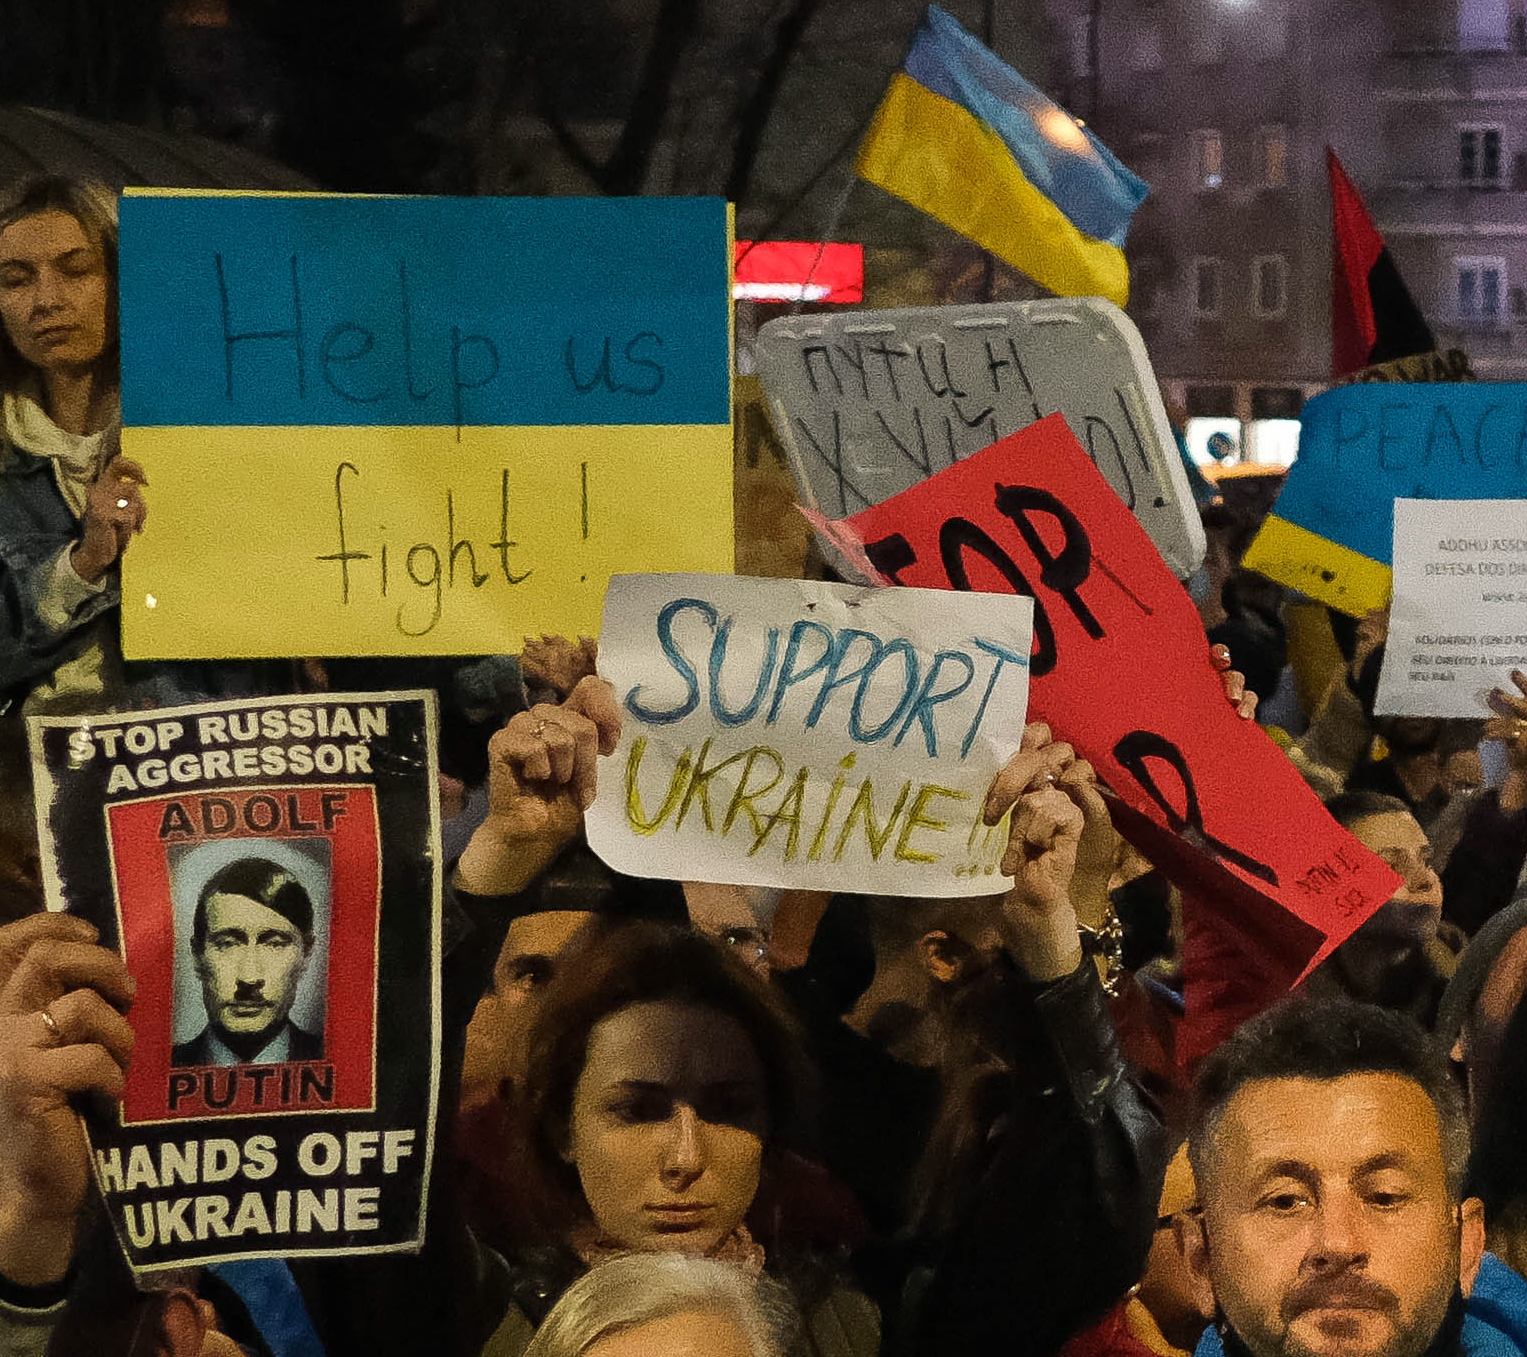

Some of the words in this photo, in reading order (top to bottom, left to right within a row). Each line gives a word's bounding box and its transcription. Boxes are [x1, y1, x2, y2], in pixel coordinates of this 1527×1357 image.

[213, 252, 499, 441] Help
[563, 325, 665, 395] us
[625, 597, 1029, 761] SUPPORT
[68, 716, 189, 765] STOP
[197, 703, 388, 748] RUSSIAN
[105, 743, 373, 795] AGGRESSOR
[158, 791, 350, 840] ADOLF
[165, 1064, 335, 1111] PUTIN
[96, 1136, 279, 1194] HANDS
[298, 1129, 414, 1179] OFF
[122, 1186, 380, 1248] UKRAINE
